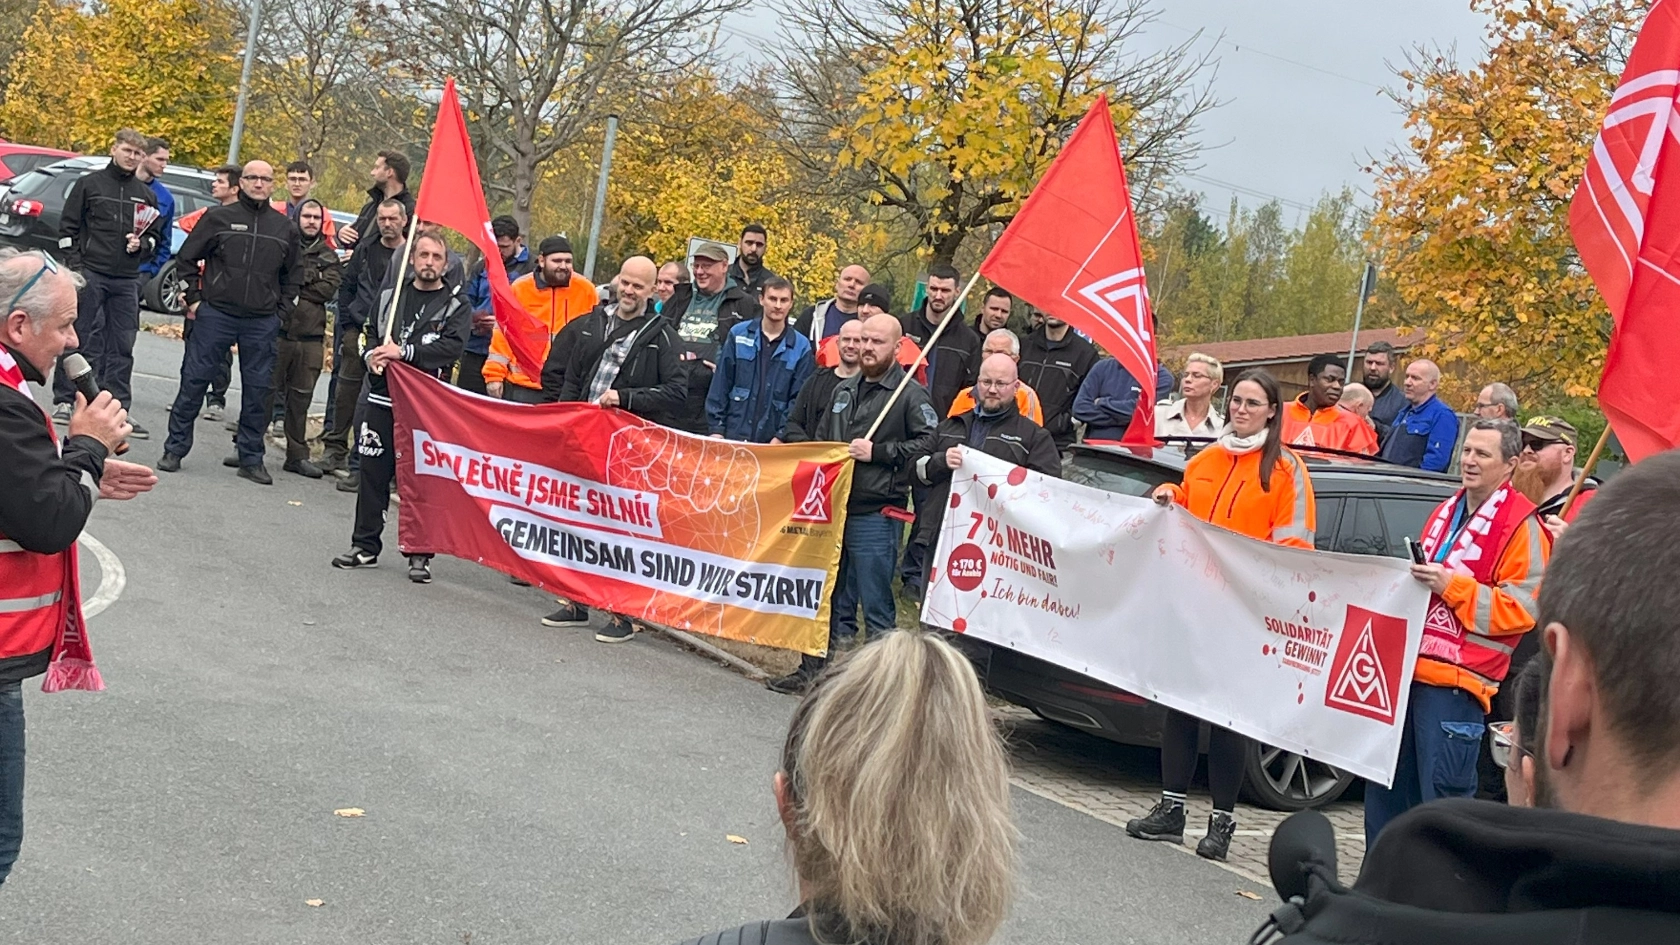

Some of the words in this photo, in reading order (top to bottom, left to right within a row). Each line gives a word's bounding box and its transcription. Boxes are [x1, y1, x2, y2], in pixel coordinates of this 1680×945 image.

[525, 473, 581, 512] JSME
[587, 488, 653, 528] SILNÍ!
[967, 511, 984, 540] 7
[988, 516, 1004, 548] %
[1006, 524, 1057, 570] MEHR
[496, 517, 636, 574] GEMEINSAM
[640, 549, 695, 587] SIND
[697, 562, 736, 596] WIR
[735, 570, 823, 611] STARK!
[990, 550, 1019, 571] NÖTIG
[1020, 561, 1037, 578] UND
[990, 578, 1016, 603] Ich
[1018, 586, 1039, 608] bin
[1041, 592, 1080, 620] dabei!
[1264, 616, 1334, 650] SOLIDARITÄT
[1285, 640, 1328, 668] GEWINNT
